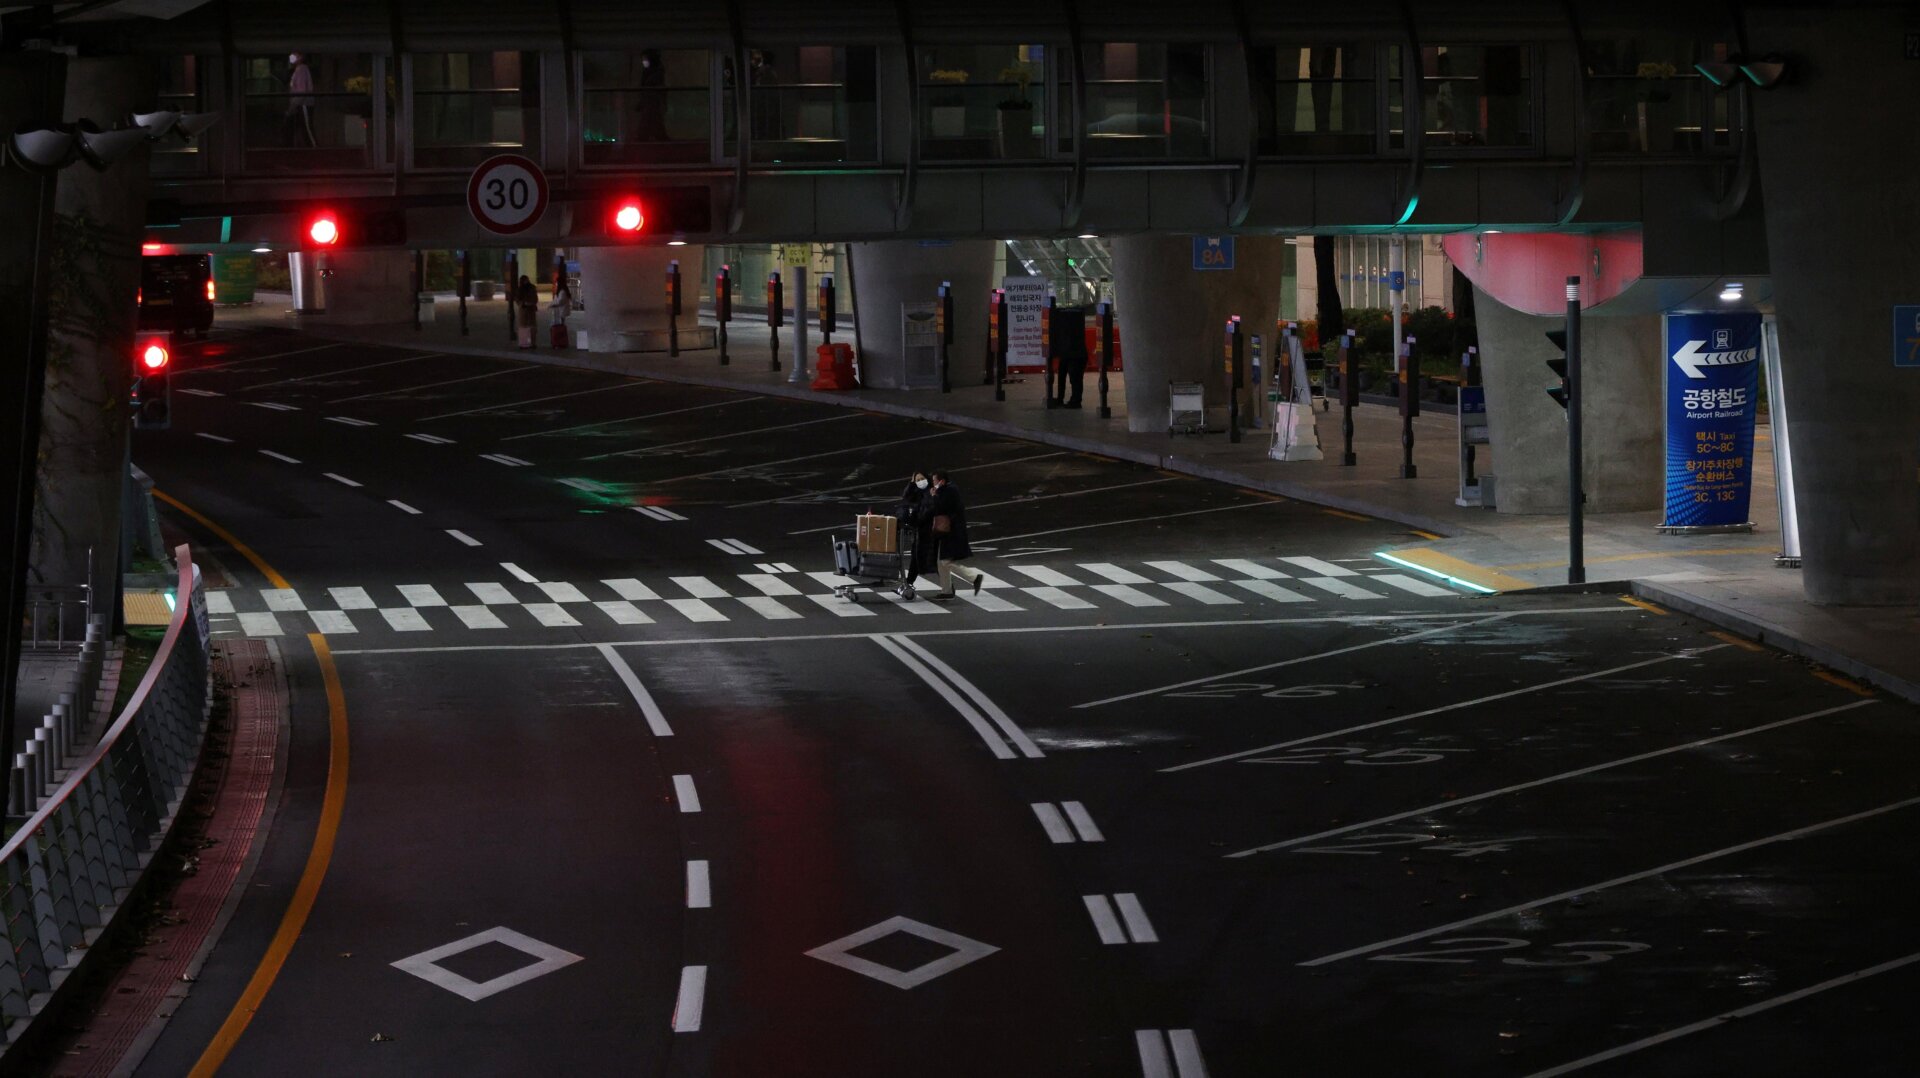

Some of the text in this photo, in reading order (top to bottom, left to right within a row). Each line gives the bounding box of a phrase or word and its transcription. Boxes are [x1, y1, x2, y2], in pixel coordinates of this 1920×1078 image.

[486, 178, 529, 210] 30
[1201, 249, 1225, 264] 8A
[1682, 387, 1747, 410] 공항철도
[1686, 409, 1743, 419] Airport Railroad
[1696, 431, 1716, 441] 택시
[1697, 442, 1735, 453] 5C~8C
[1717, 490, 1735, 501] 13C
[1161, 683, 1366, 698] 26
[1237, 746, 1477, 765] 25
[1289, 832, 1539, 857] 24
[1368, 937, 1652, 966] 23
